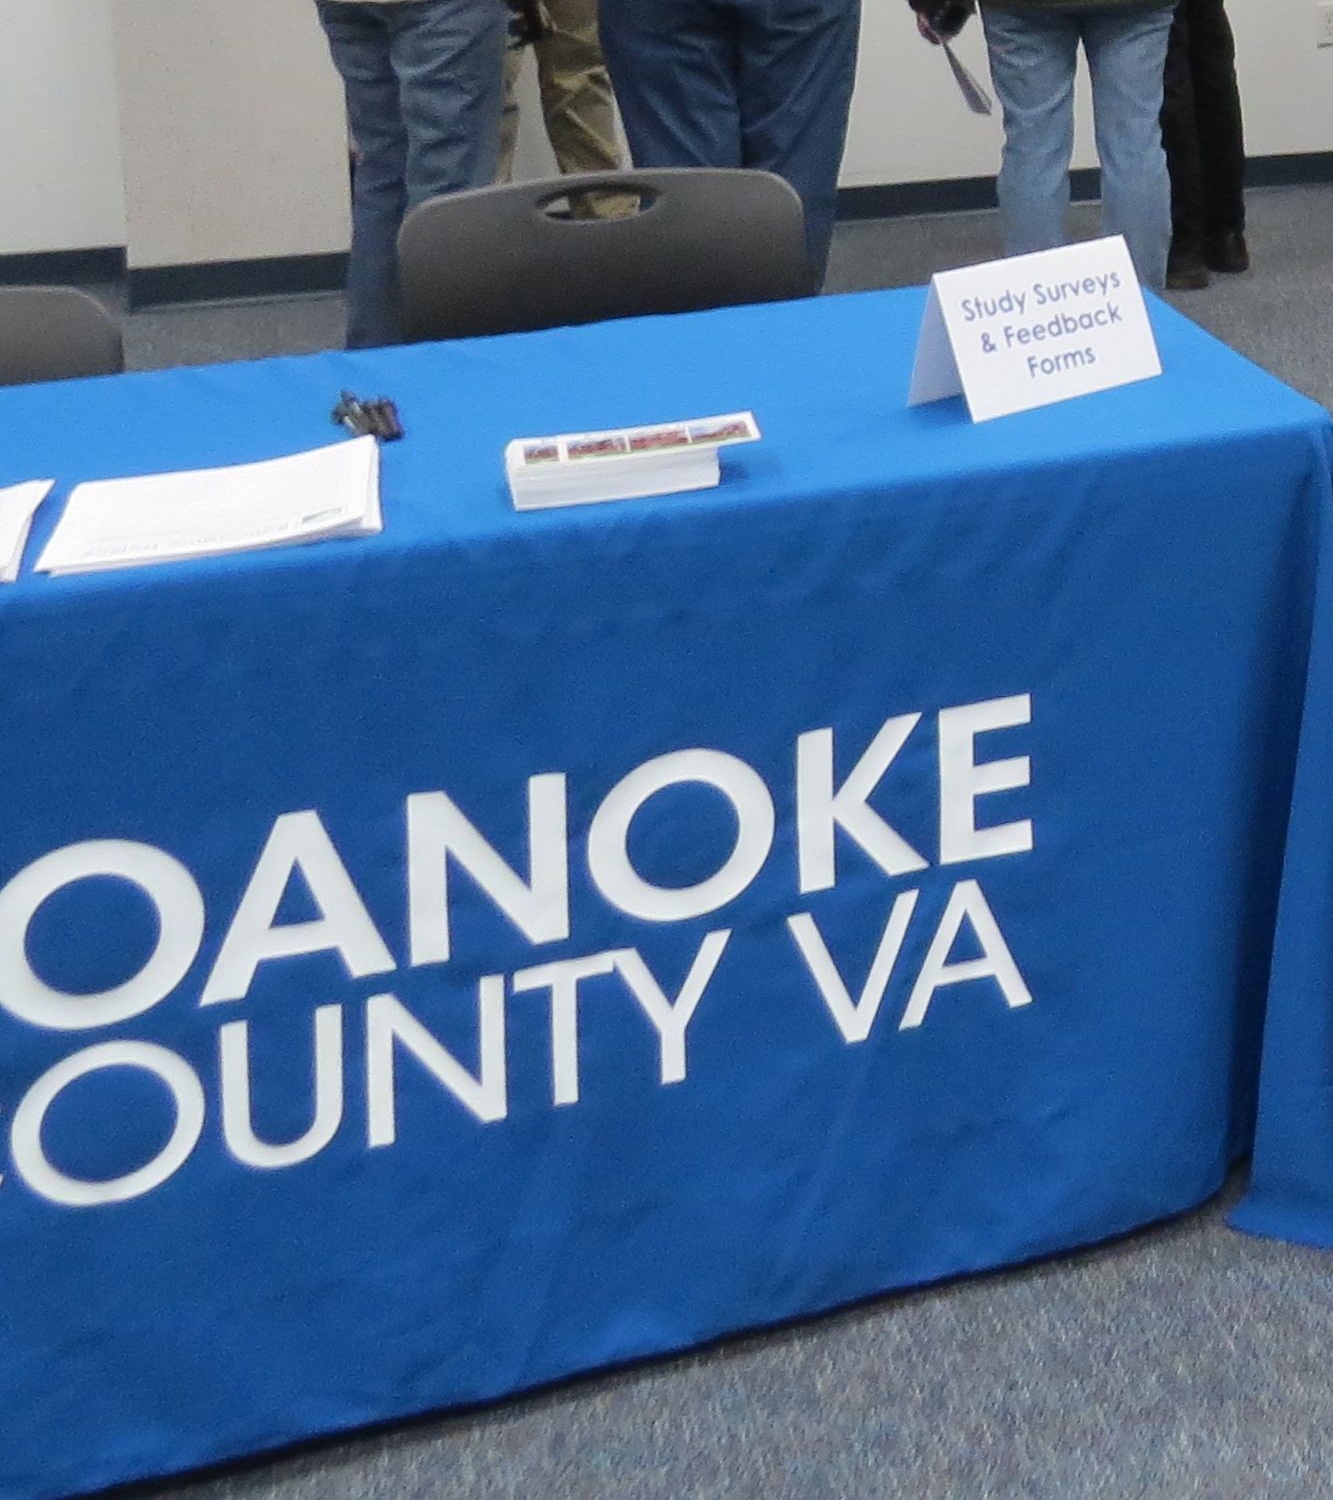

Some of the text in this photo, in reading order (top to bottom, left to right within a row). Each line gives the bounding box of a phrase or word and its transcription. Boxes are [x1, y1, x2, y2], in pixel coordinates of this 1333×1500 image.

[961, 271, 1122, 322] Study Surveys
[980, 302, 1123, 354] & Feedback
[1026, 346, 1096, 379] Forms
[0, 693, 1033, 1031] OANOKE
[0, 879, 1033, 1207] OUNTY VA
